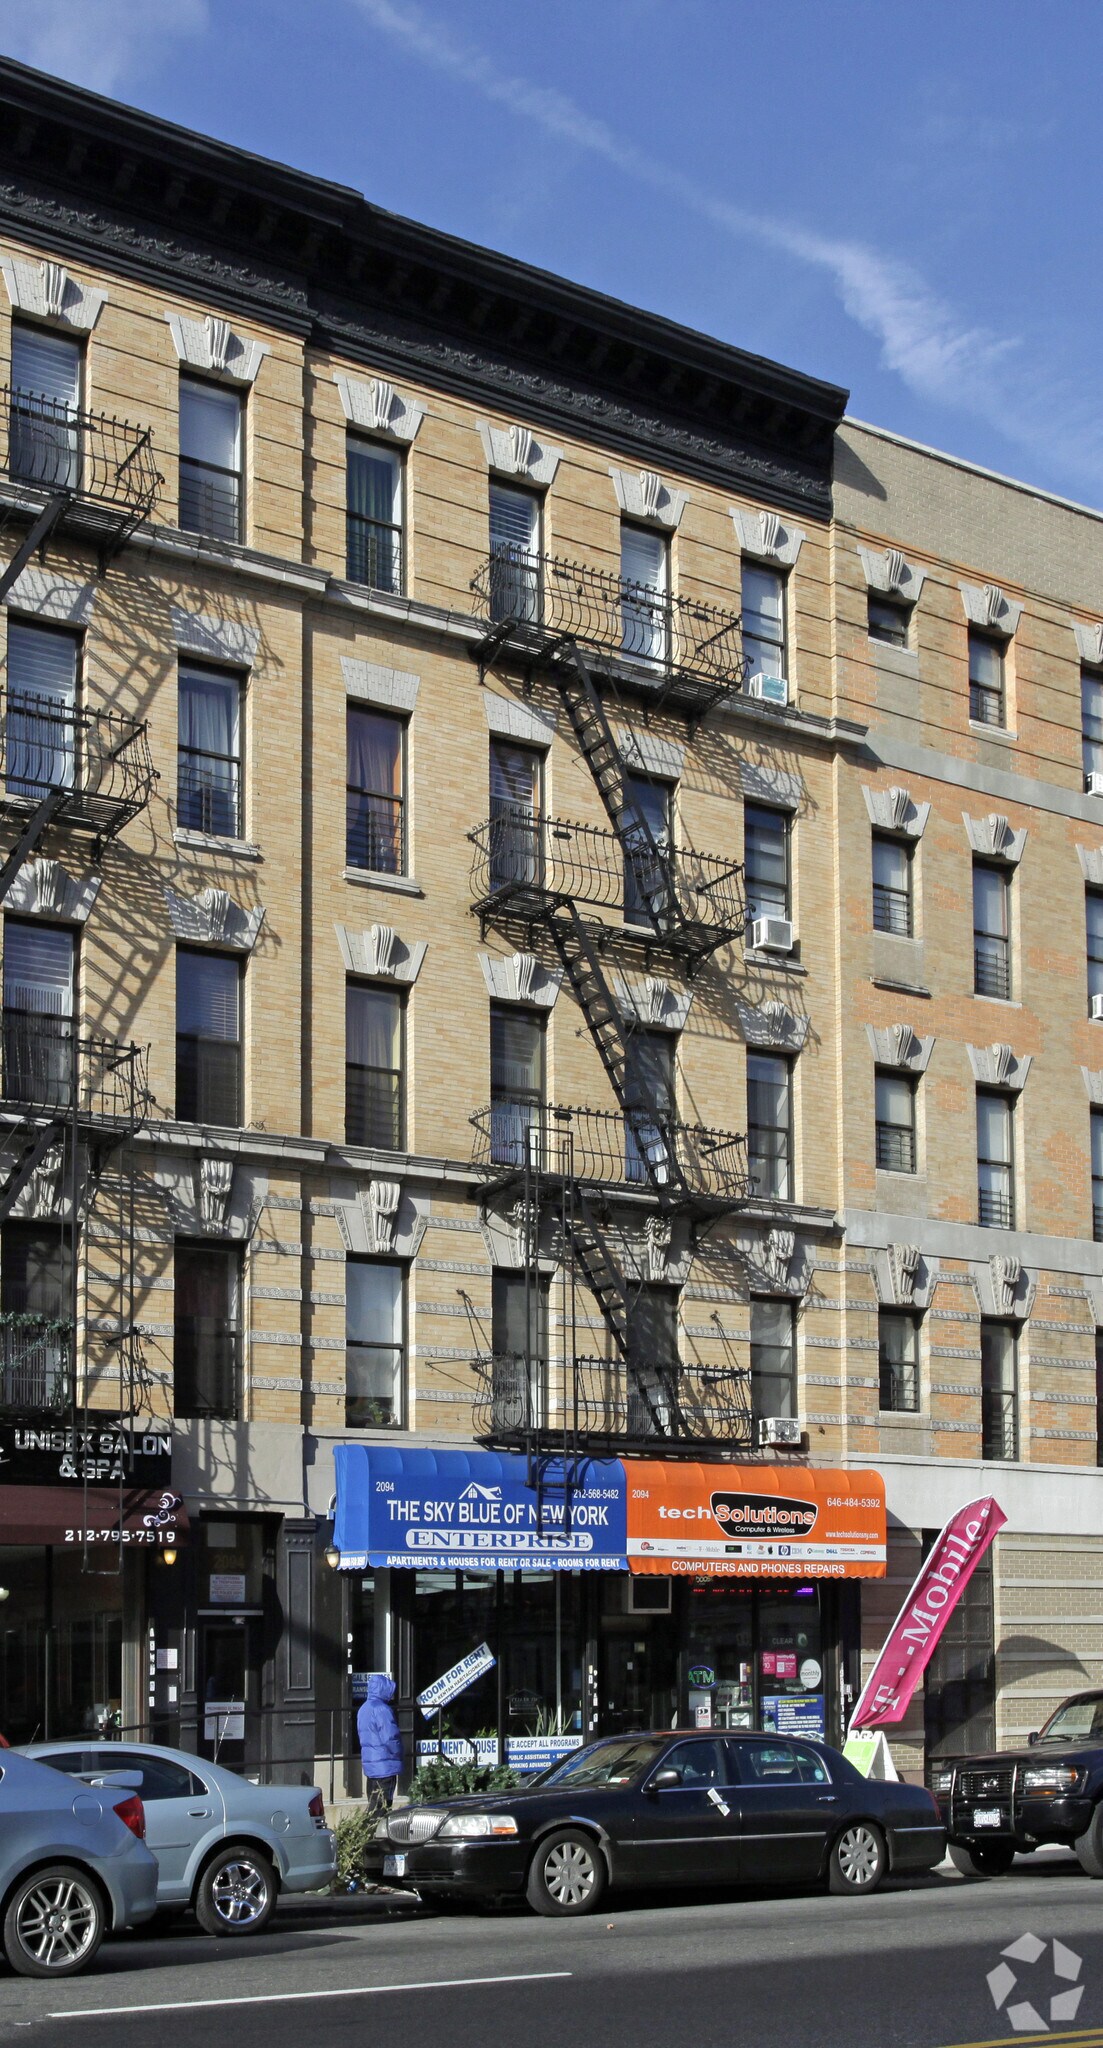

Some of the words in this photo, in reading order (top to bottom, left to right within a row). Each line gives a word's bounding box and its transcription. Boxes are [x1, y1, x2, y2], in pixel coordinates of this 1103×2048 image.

[15, 1429, 94, 1452] UNISEX
[59, 1454, 78, 1478] &
[82, 1459, 126, 1480] SPA
[376, 1481, 395, 1492] 2094
[573, 1488, 619, 1499] 212-568-5482
[632, 1489, 649, 1499] 2094
[826, 1497, 880, 1508] 646-484-5392
[387, 1500, 420, 1521] THE
[423, 1501, 455, 1522] SKY
[459, 1502, 500, 1523] BLUE
[504, 1503, 525, 1524] OF
[529, 1504, 565, 1524] NEW
[568, 1505, 609, 1526] YORK
[735, 1525, 766, 1534] Computer
[825, 1531, 879, 1540] www.techsolutionsny.com
[411, 1531, 590, 1548] ENTERPRISE
[386, 1555, 438, 1566] APARTMENTS
[440, 1556, 447, 1566] &
[447, 1557, 479, 1567] HOUSES
[480, 1557, 496, 1567] FOR
[498, 1557, 518, 1567] RENT
[519, 1558, 531, 1568] OR
[532, 1558, 551, 1568] SALE
[557, 1558, 584, 1568] ROOMS
[585, 1558, 600, 1567] FOR
[601, 1558, 620, 1568] RENT
[671, 1560, 736, 1572] COMPUTERS
[737, 1563, 759, 1573] AND
[761, 1563, 802, 1573] PHONES
[804, 1564, 845, 1574] REPAIRS
[772, 1637, 794, 1645] CLEAR
[420, 1679, 447, 1704] ROOM
[445, 1665, 464, 1683] FOR
[463, 1645, 486, 1669] RENT
[688, 1670, 715, 1684] ATM
[506, 1740, 515, 1748] WE
[516, 1740, 537, 1748] ACCEPT
[539, 1739, 549, 1747] ALL
[550, 1738, 580, 1747] PROGRAMS
